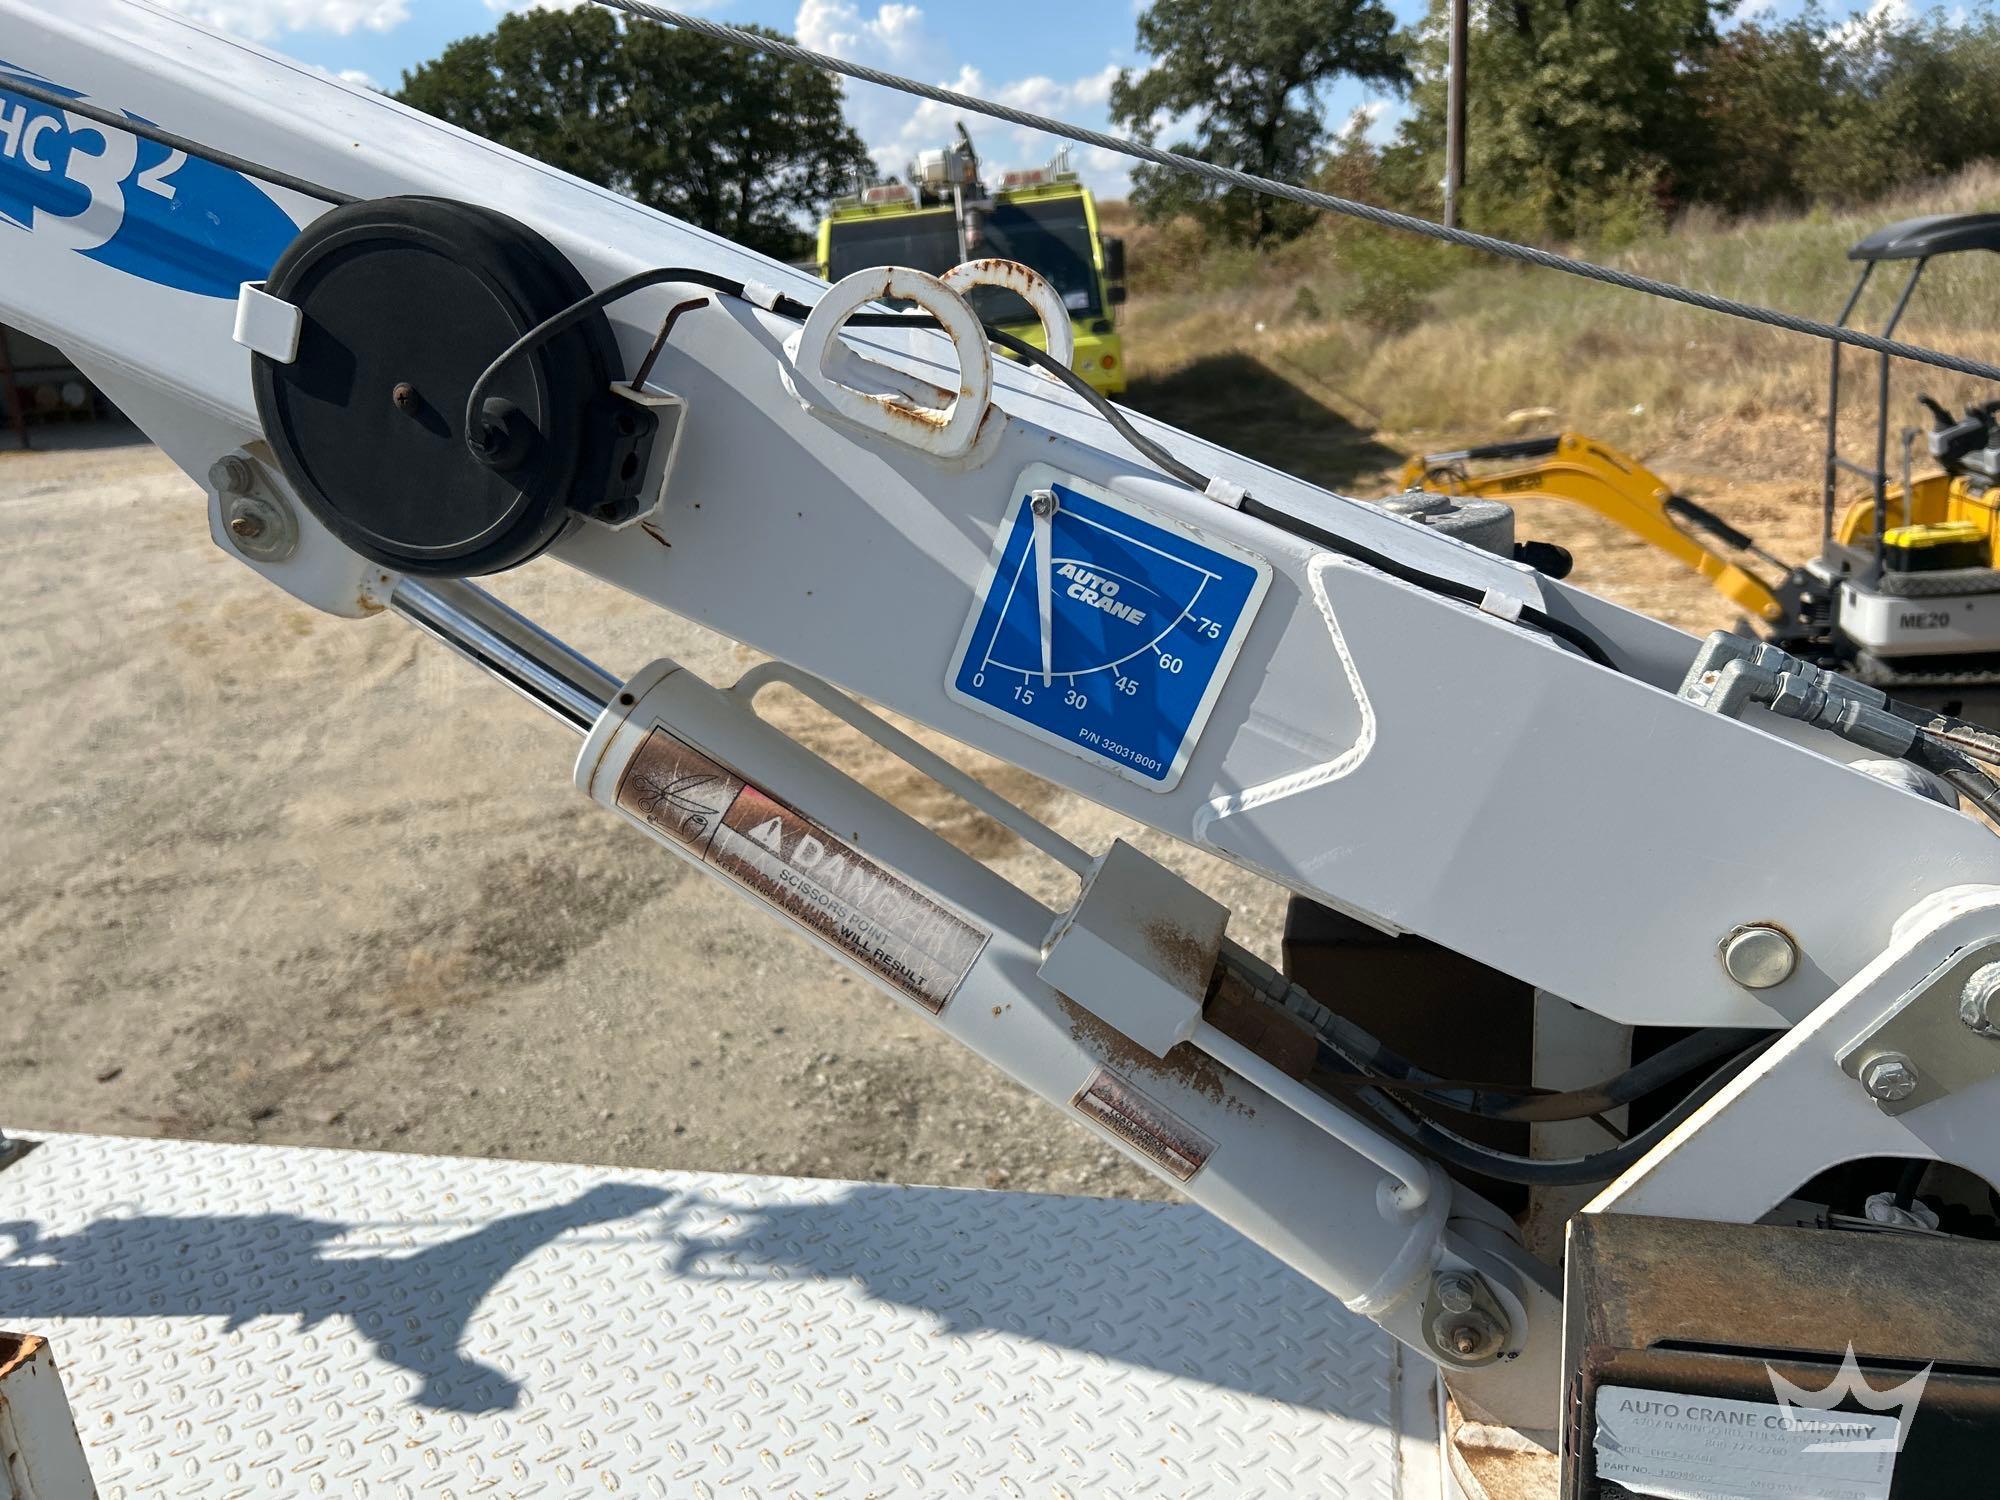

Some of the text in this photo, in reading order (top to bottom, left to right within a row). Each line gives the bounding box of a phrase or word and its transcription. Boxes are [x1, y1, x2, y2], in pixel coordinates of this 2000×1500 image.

[1056, 562, 1120, 597] AUTO
[1066, 585, 1147, 626] CRANE
[1199, 616, 1222, 639] 75
[1900, 612, 1950, 629] ME20
[1159, 655, 1183, 674] 60
[973, 673, 985, 688] 0
[1115, 675, 1139, 696] 45
[1013, 685, 1035, 705] 15
[1064, 690, 1087, 710] 30
[1079, 727, 1162, 773] P/N 320318001
[713, 857, 741, 878] KEEP
[741, 875, 778, 902] HANDS
[777, 899, 800, 916] AND
[799, 913, 830, 937] ARMS
[829, 932, 865, 959] CLEAR
[777, 867, 889, 945] SCISSORS POINT
[837, 924, 874, 953] WILL
[872, 947, 927, 988] RESULT
[1619, 1399, 1876, 1441] AUTO CRANE COMPANY
[1603, 1462, 1630, 1472] PART
